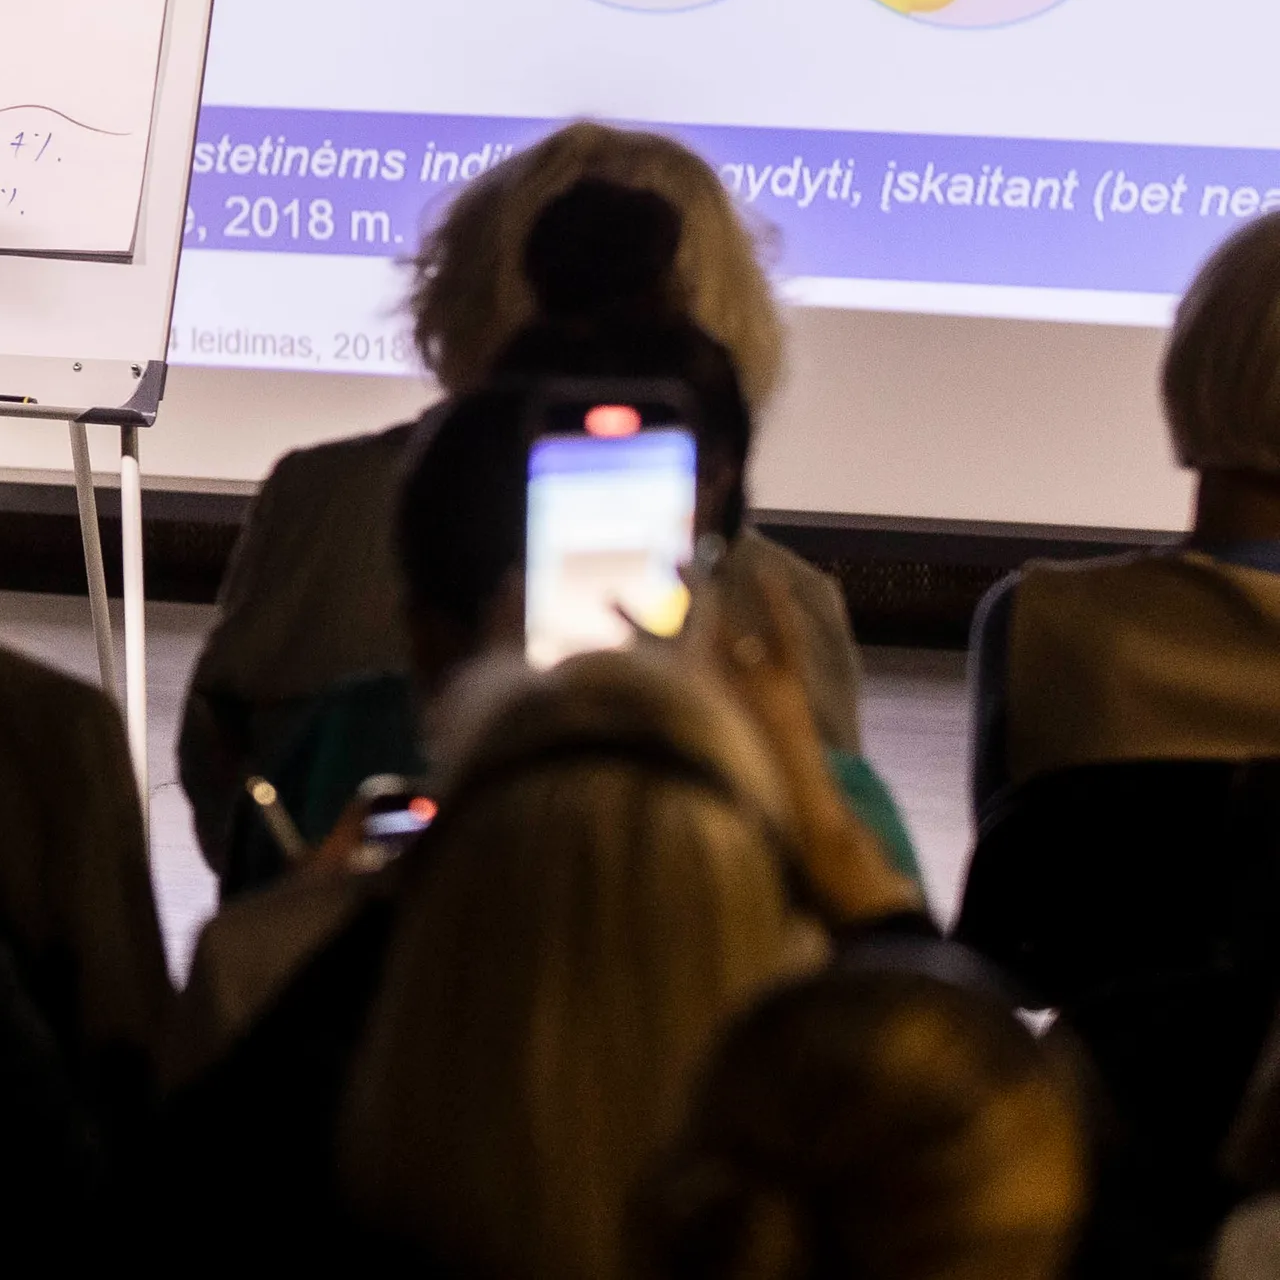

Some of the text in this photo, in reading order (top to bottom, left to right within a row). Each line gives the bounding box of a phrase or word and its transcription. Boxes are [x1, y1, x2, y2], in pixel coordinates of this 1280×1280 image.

[192, 133, 408, 182] stetinėms
[880, 159, 1080, 213] įskaitant
[1093, 168, 1189, 222] (bet
[223, 195, 336, 241] 2018
[350, 207, 404, 245] m.
[191, 325, 321, 363] leidimas,
